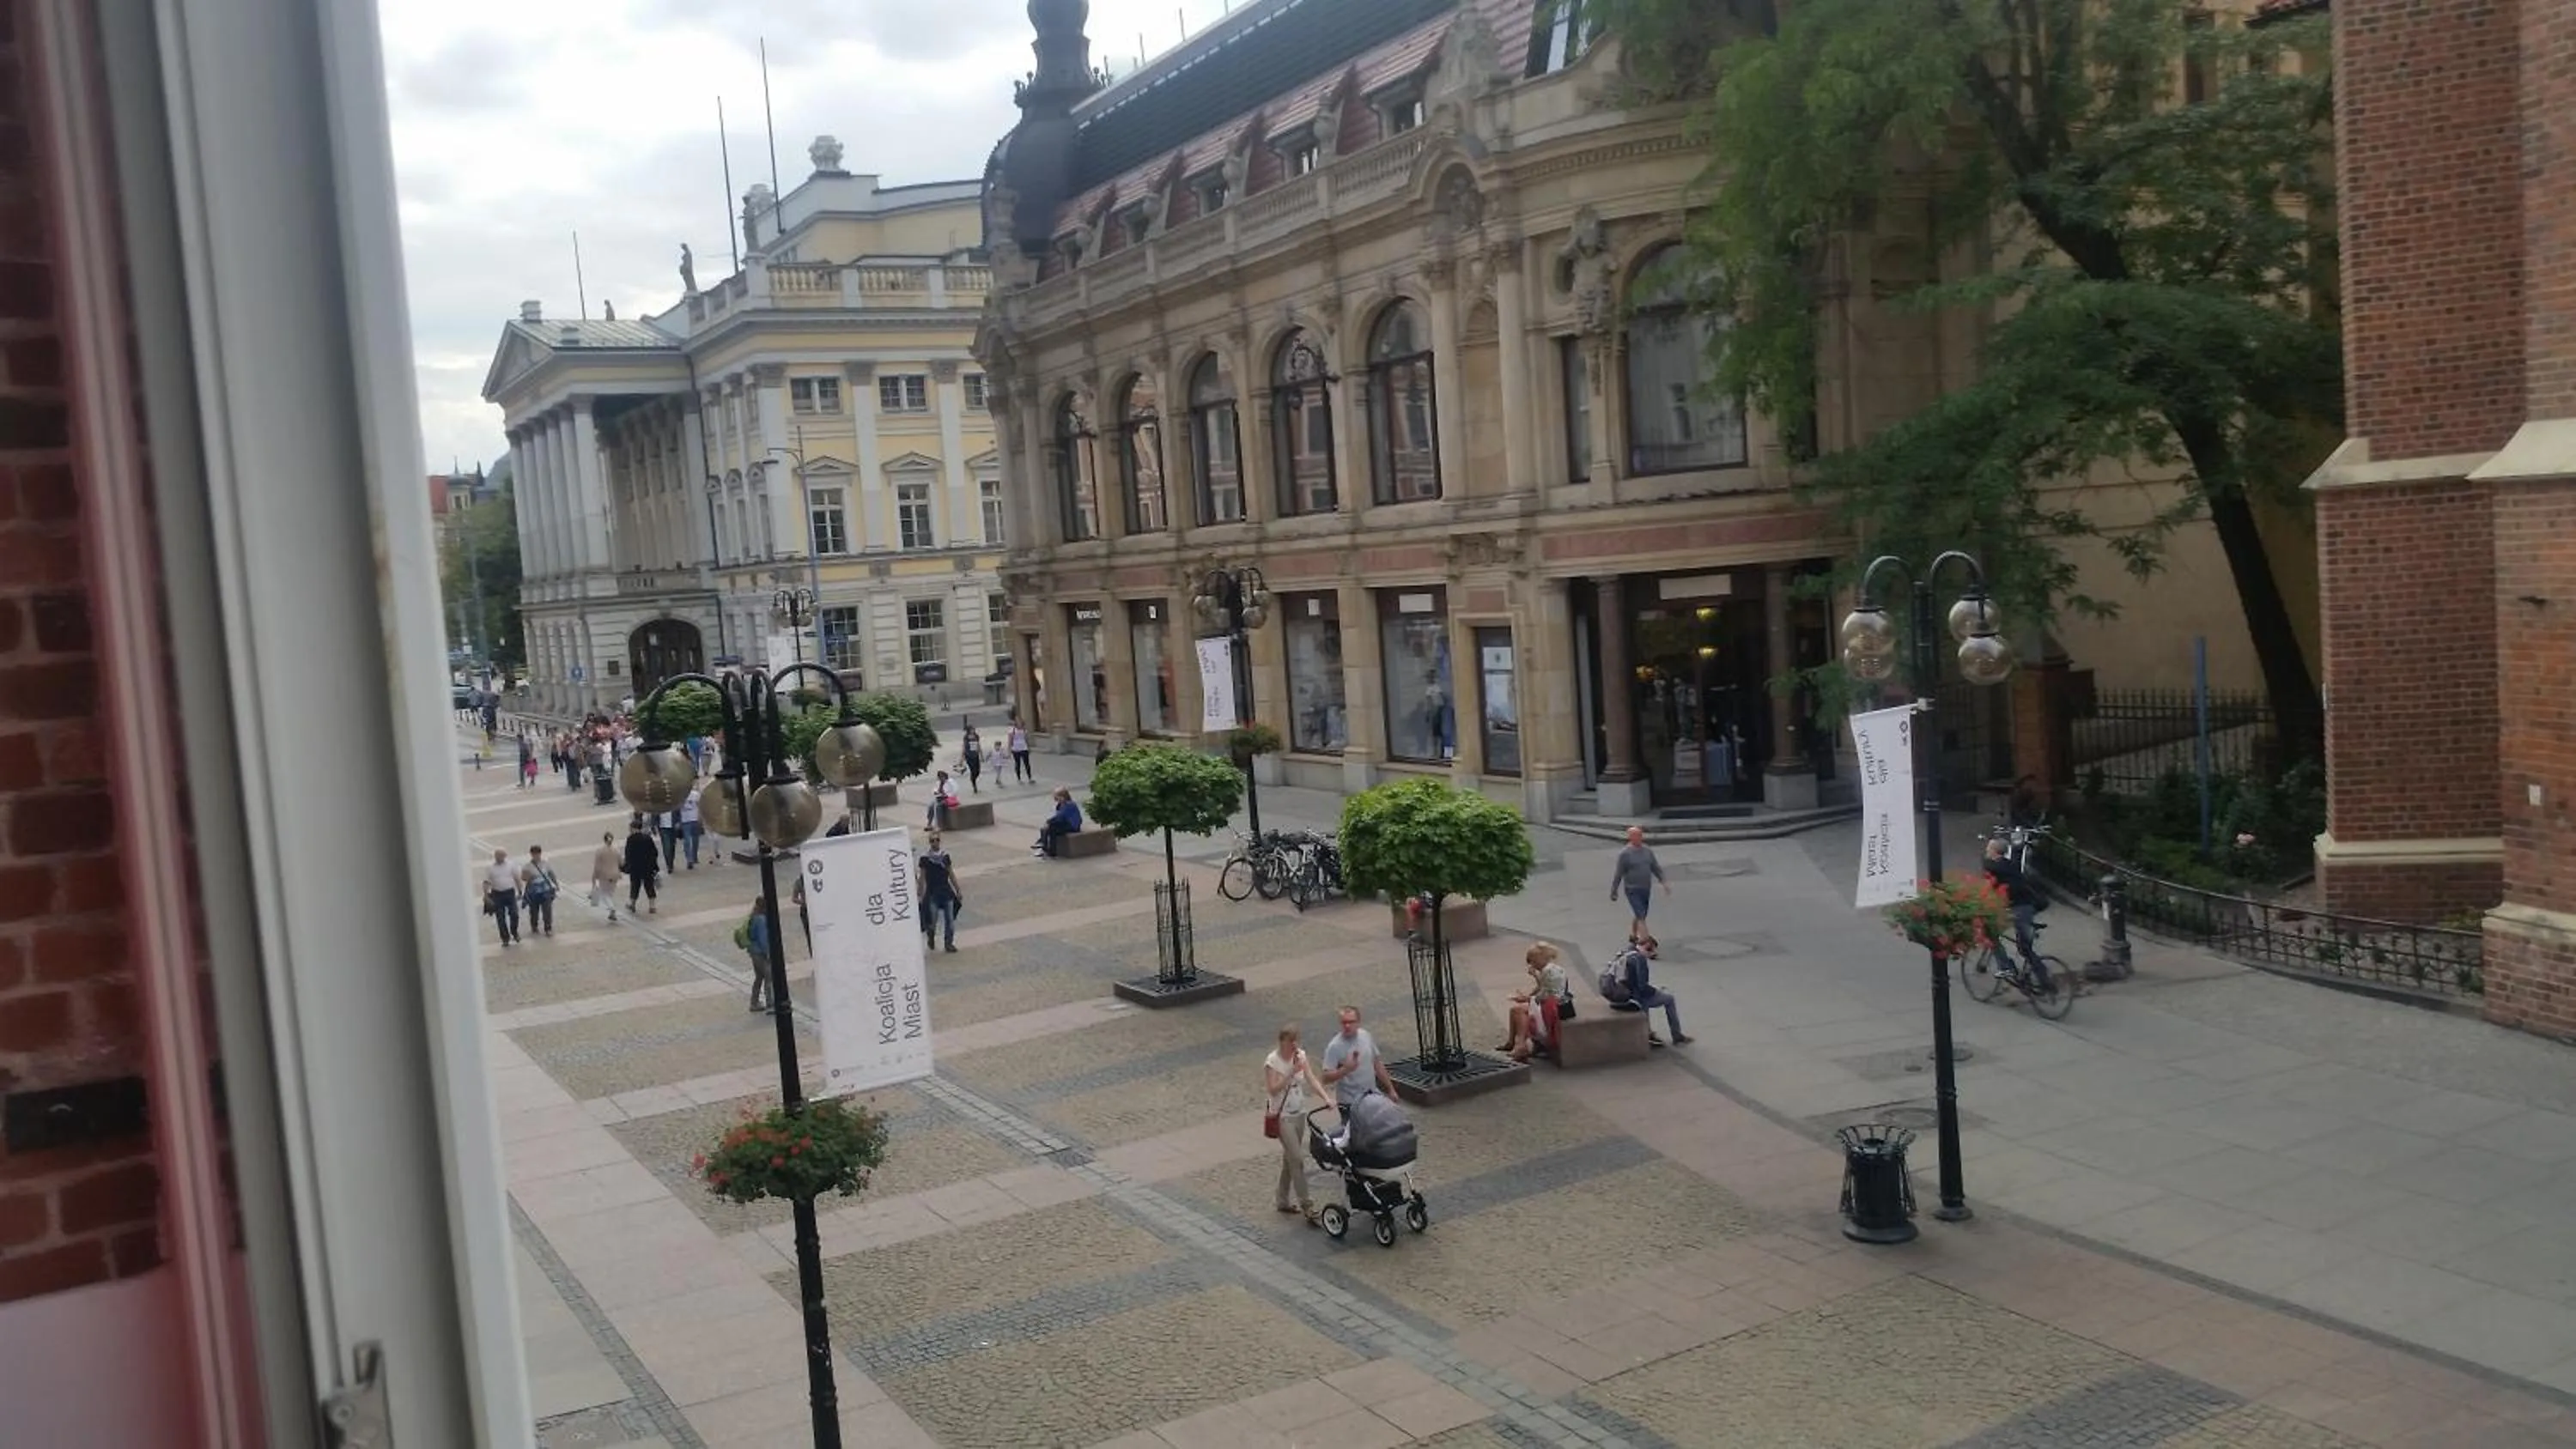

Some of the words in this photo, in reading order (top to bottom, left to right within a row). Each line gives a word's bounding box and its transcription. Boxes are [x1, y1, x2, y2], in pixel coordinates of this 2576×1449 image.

[866, 893, 885, 925] dla
[888, 848, 911, 922] Kultury
[876, 961, 897, 1046] Koalicja
[902, 980, 923, 1040] Miast
